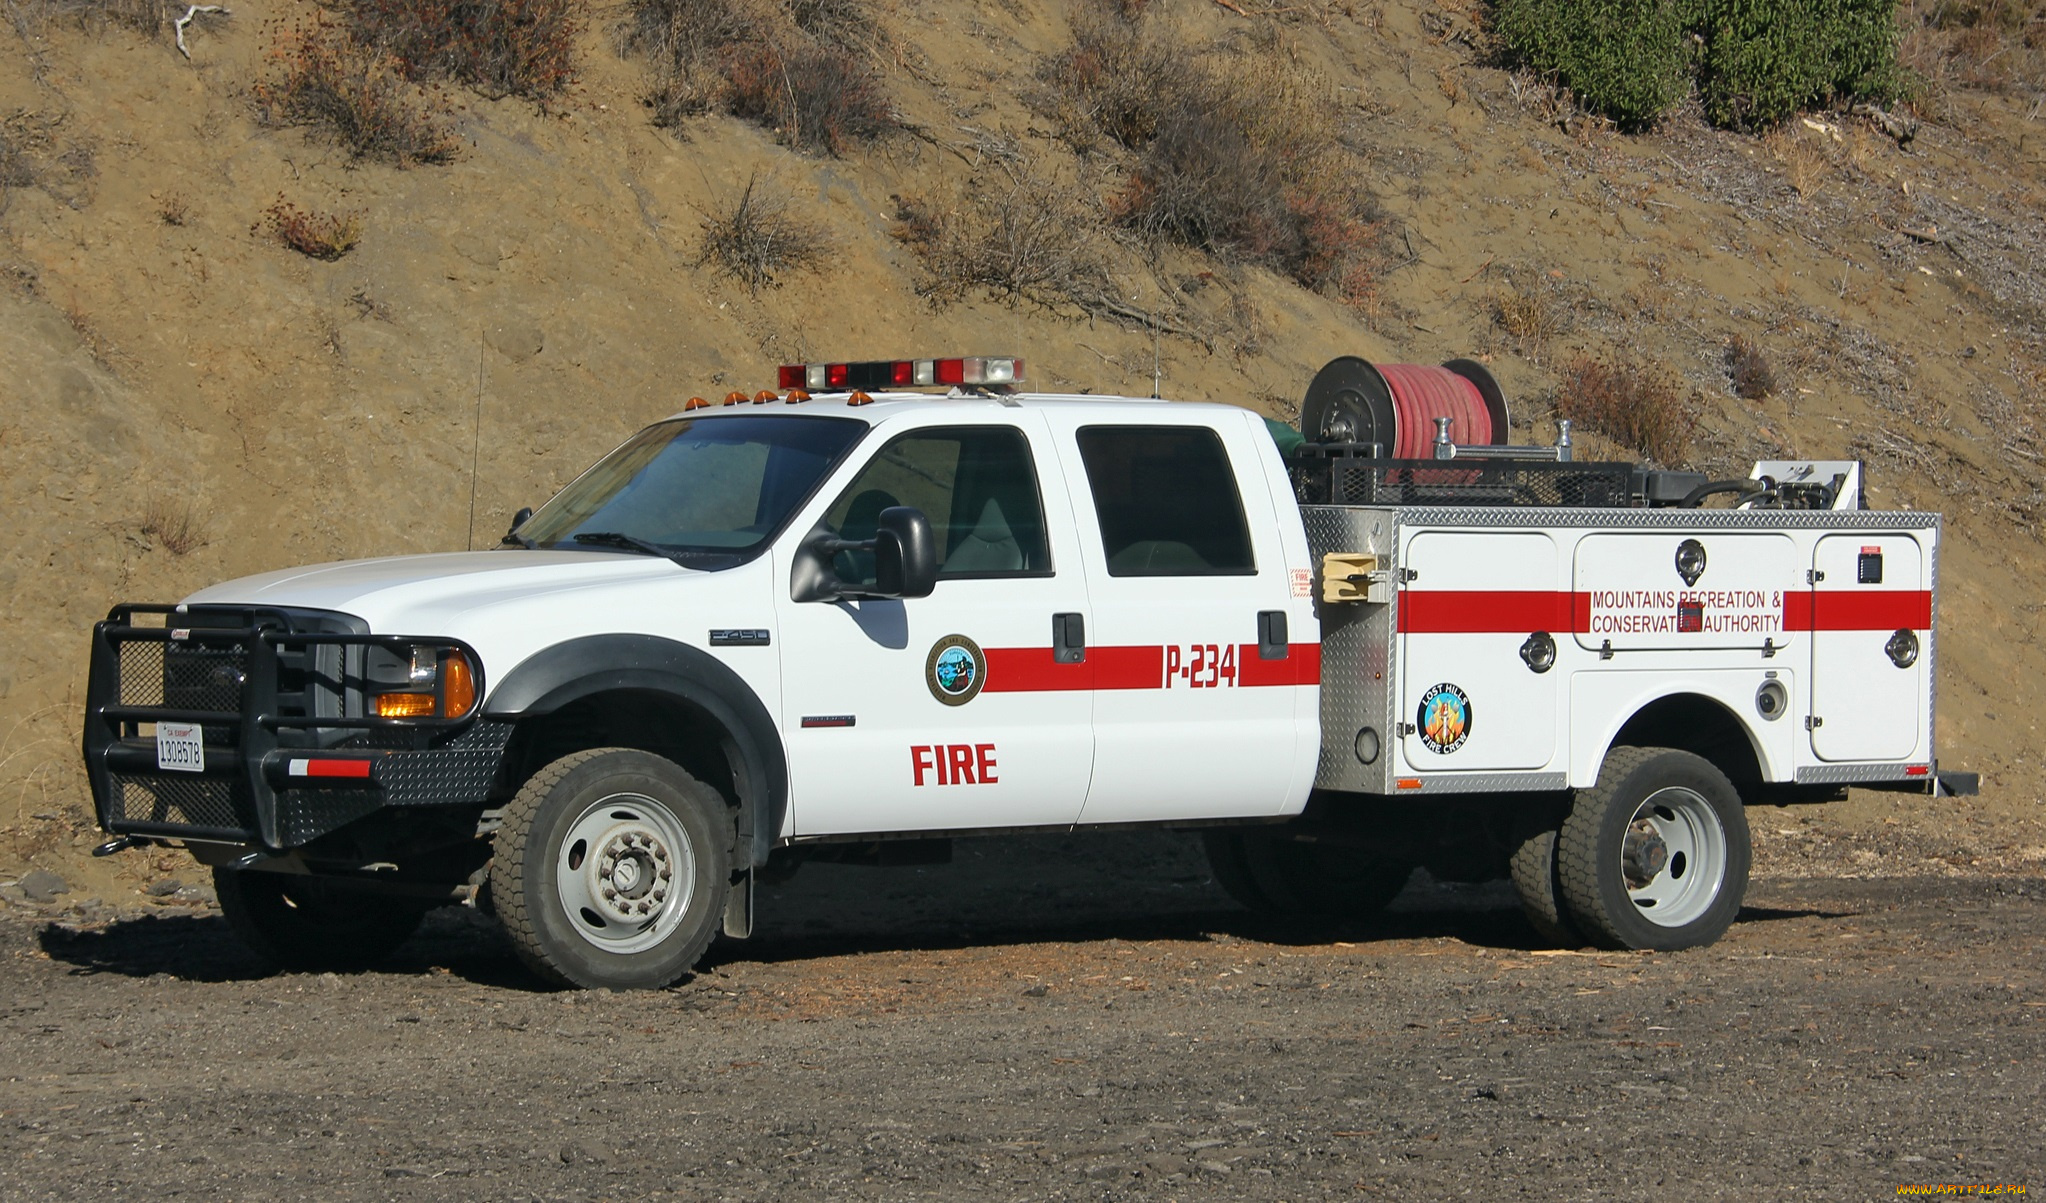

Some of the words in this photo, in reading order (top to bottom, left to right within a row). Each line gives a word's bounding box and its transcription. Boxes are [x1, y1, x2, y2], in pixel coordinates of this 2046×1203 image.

[1295, 573, 1309, 581] FIRE
[1592, 590, 1675, 609] MOUNTAINS
[1679, 590, 1765, 609] RECREATION
[1772, 590, 1781, 608] &
[1703, 614, 1781, 632] AUTHORITY
[1165, 644, 1237, 689] P-234
[1422, 684, 1443, 707] LOST
[1445, 683, 1468, 707] HILLS
[160, 739, 201, 765] 1308578
[1422, 734, 1442, 754] FIRE
[1443, 731, 1467, 755] CREW
[910, 743, 999, 787] FIRE
